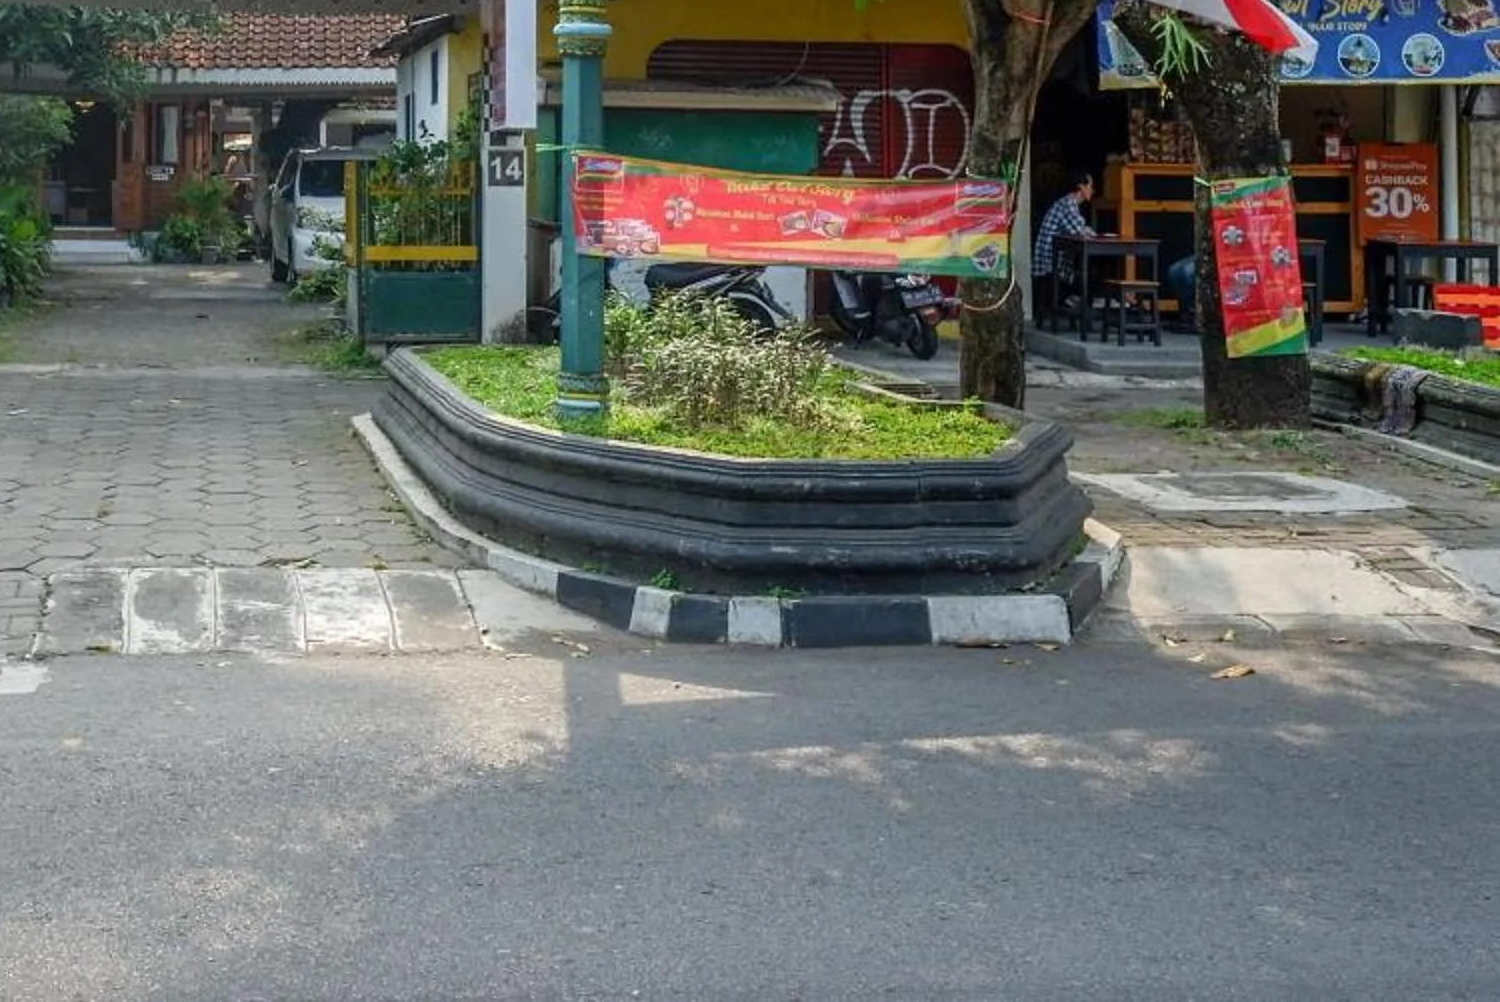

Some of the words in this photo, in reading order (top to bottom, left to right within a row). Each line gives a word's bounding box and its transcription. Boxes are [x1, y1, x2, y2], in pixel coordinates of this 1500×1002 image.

[490, 156, 522, 180] 14
[1365, 174, 1428, 185] CASHBACK
[1364, 186, 1430, 219] 30%
